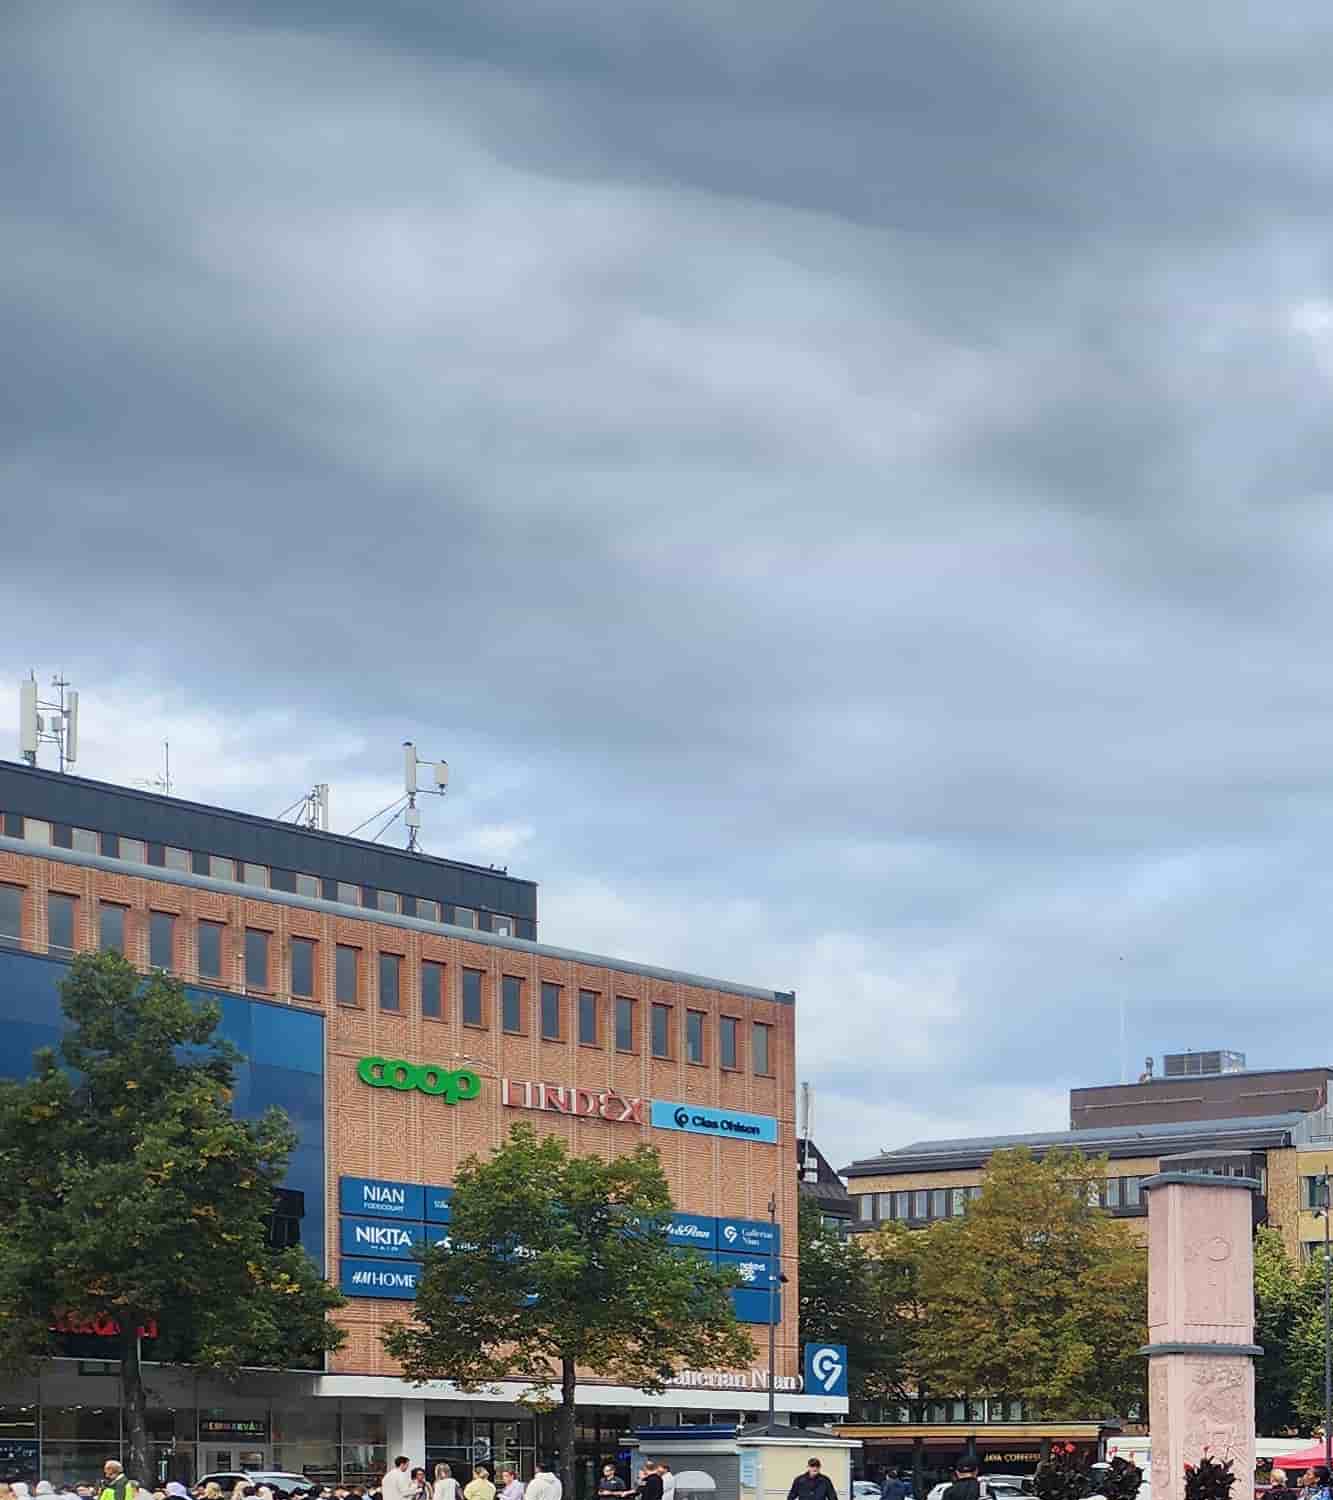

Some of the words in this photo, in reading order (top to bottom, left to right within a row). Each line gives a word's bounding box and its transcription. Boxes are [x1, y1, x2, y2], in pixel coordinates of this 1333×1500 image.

[357, 1056, 481, 1105] coop
[692, 1115, 718, 1129] Clas
[720, 1119, 761, 1136] Ohlson
[364, 1185, 405, 1203] NIAN
[355, 1226, 413, 1247] NIKITA
